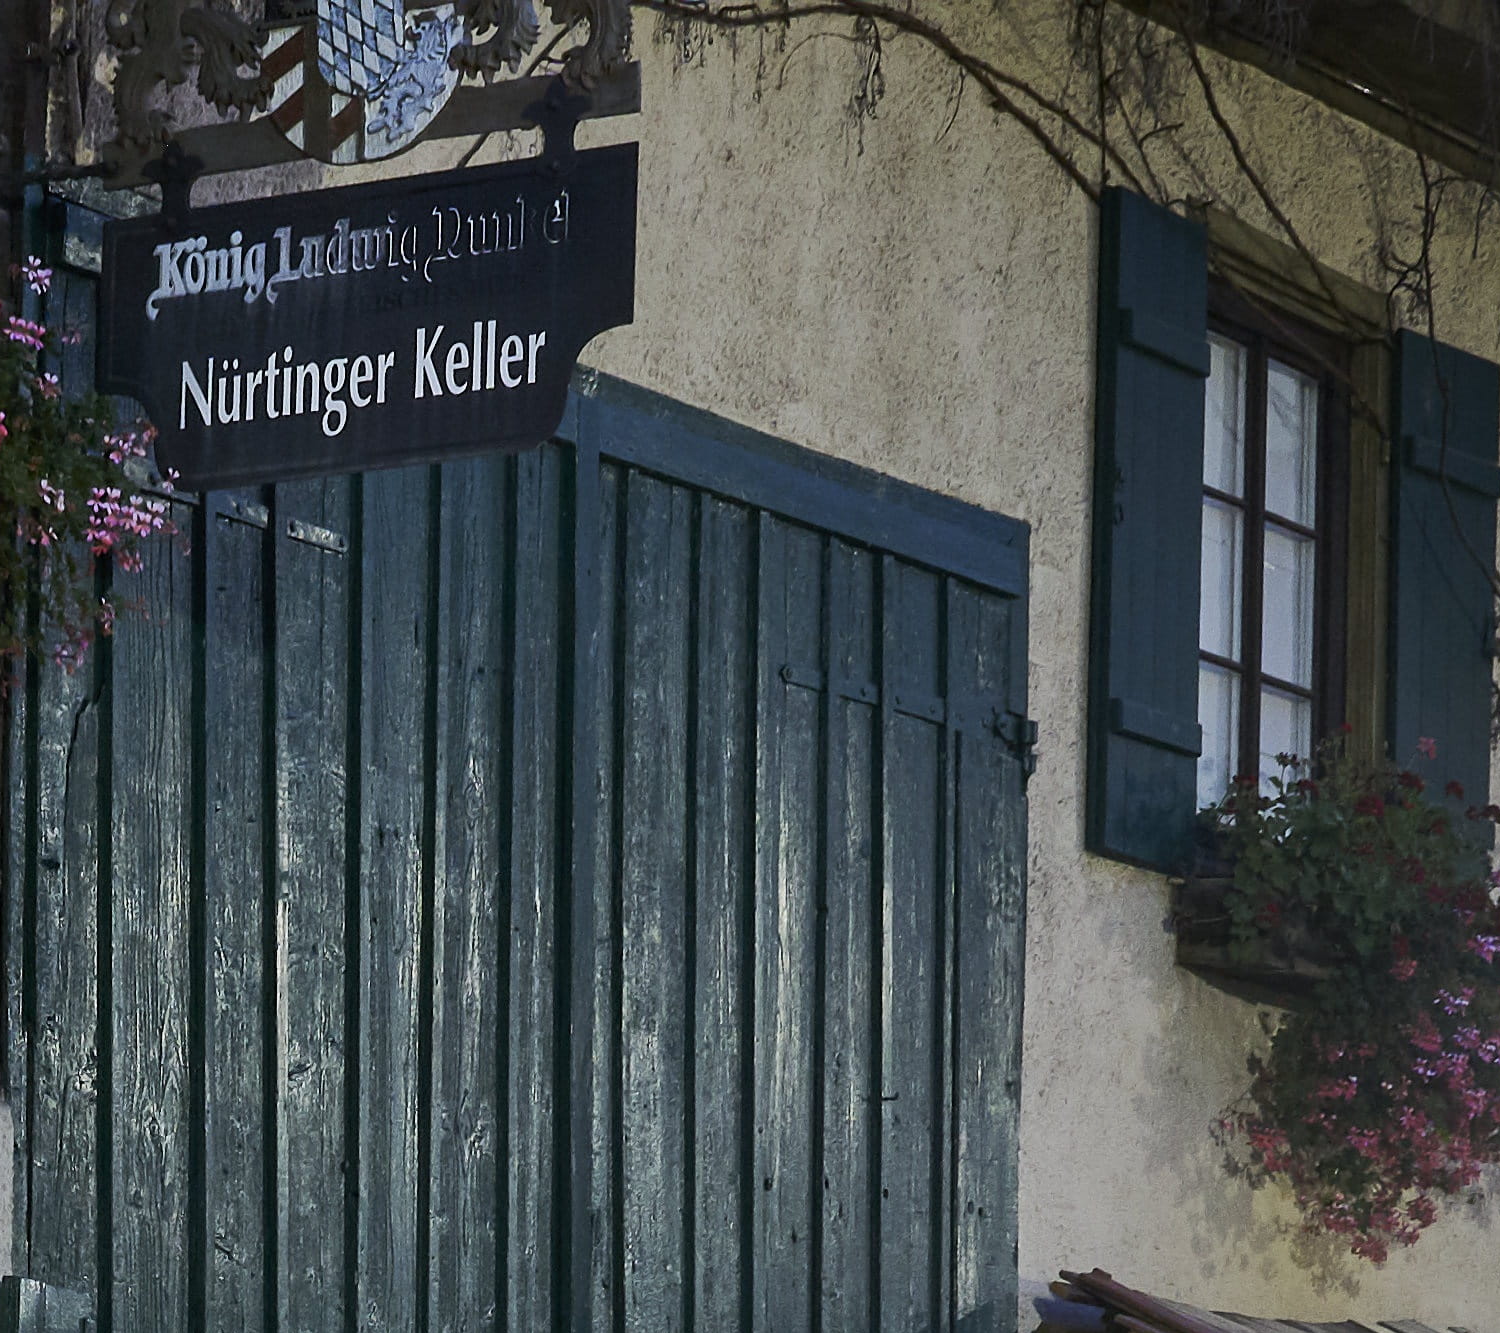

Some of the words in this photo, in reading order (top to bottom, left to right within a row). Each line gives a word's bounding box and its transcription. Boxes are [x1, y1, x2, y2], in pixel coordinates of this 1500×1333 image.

[146, 230, 268, 321] König
[265, 212, 419, 305] Ludwig
[179, 345, 395, 437] Nürtinger
[414, 319, 546, 399] Keller
